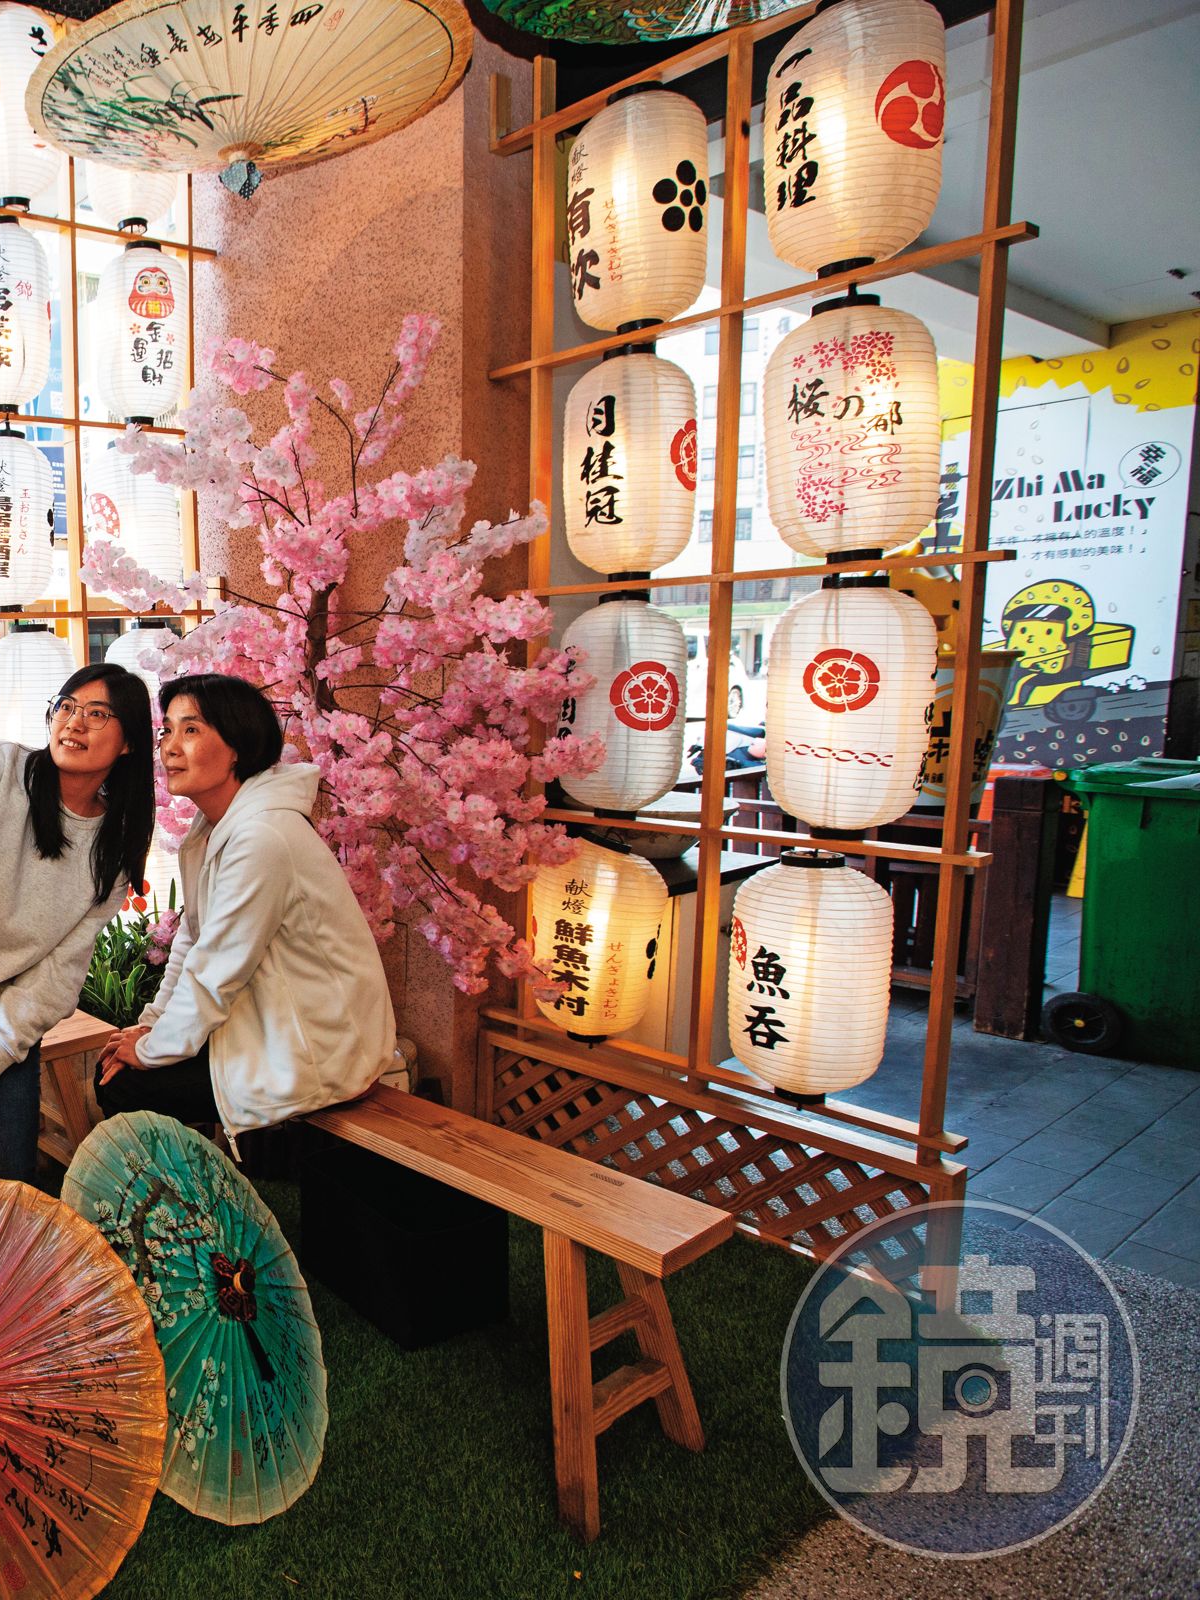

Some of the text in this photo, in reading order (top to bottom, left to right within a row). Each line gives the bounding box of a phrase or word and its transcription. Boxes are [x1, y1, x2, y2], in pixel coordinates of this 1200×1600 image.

[776, 47, 819, 212] 一品料理
[787, 378, 903, 436] 桜の都
[579, 395, 623, 528] 月桂冠
[1053, 470, 1105, 494] Ma
[1130, 444, 1166, 486] 幸福
[1053, 493, 1156, 522] Lucky
[742, 945, 791, 1050] 魚呑
